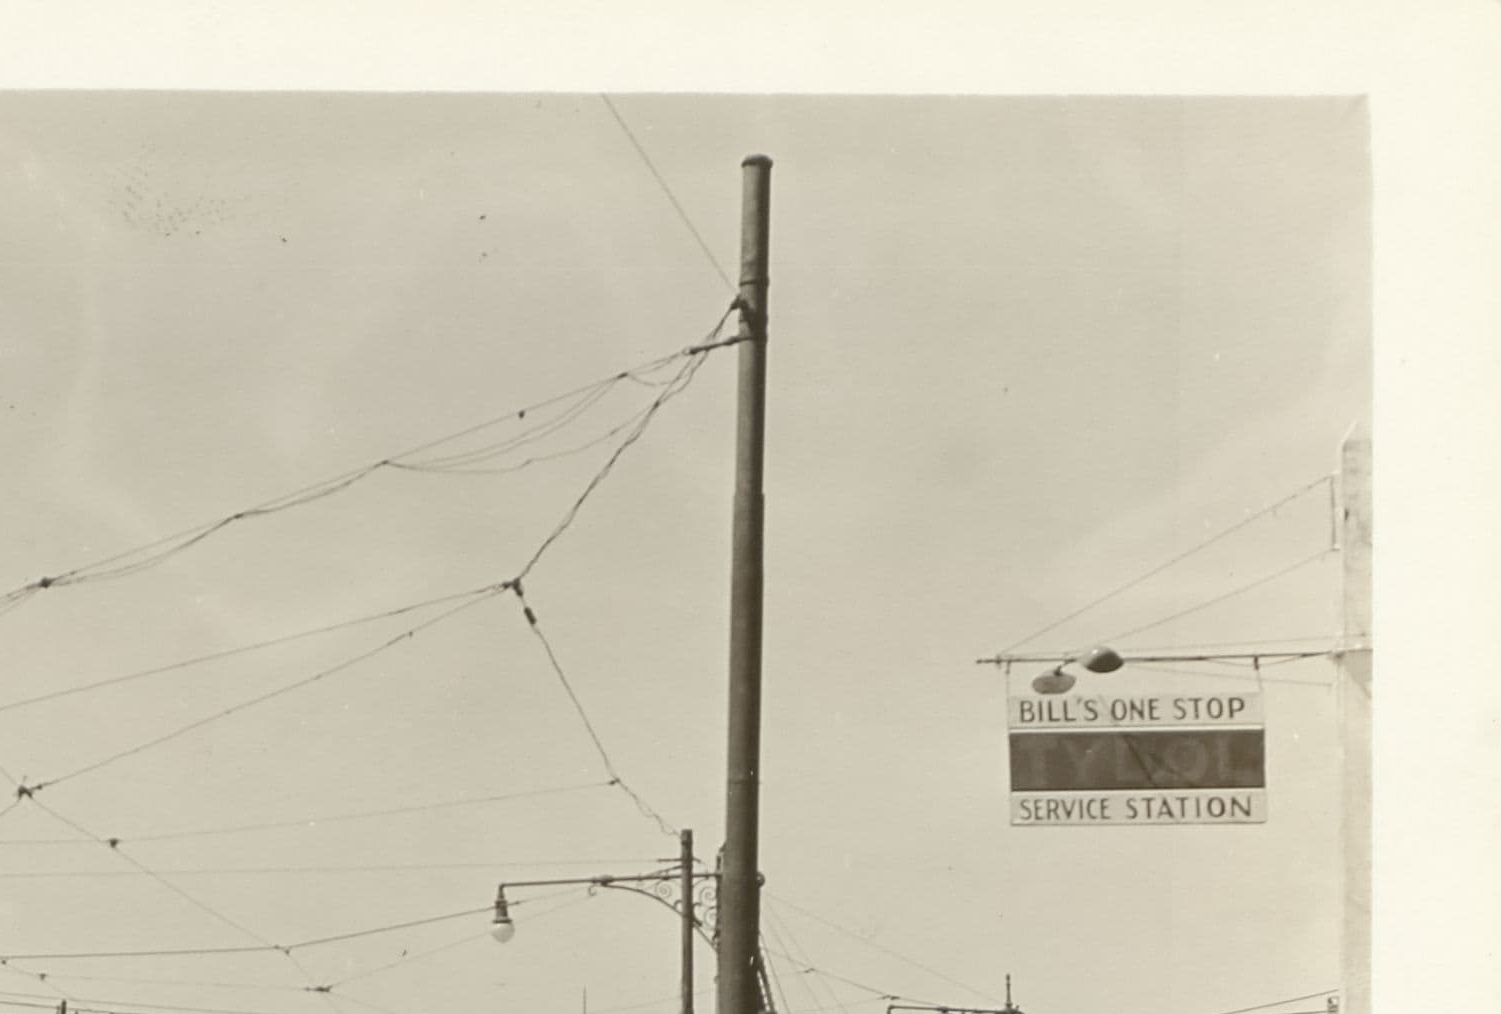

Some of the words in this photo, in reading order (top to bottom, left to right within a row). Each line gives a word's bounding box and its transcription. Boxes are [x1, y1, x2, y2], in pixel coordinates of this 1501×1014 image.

[1019, 697, 1099, 723] BILL'S
[1110, 698, 1160, 721] ONE
[1173, 696, 1245, 720] STOP
[1019, 798, 1111, 821] SERVICE
[1125, 796, 1252, 819] STATION
